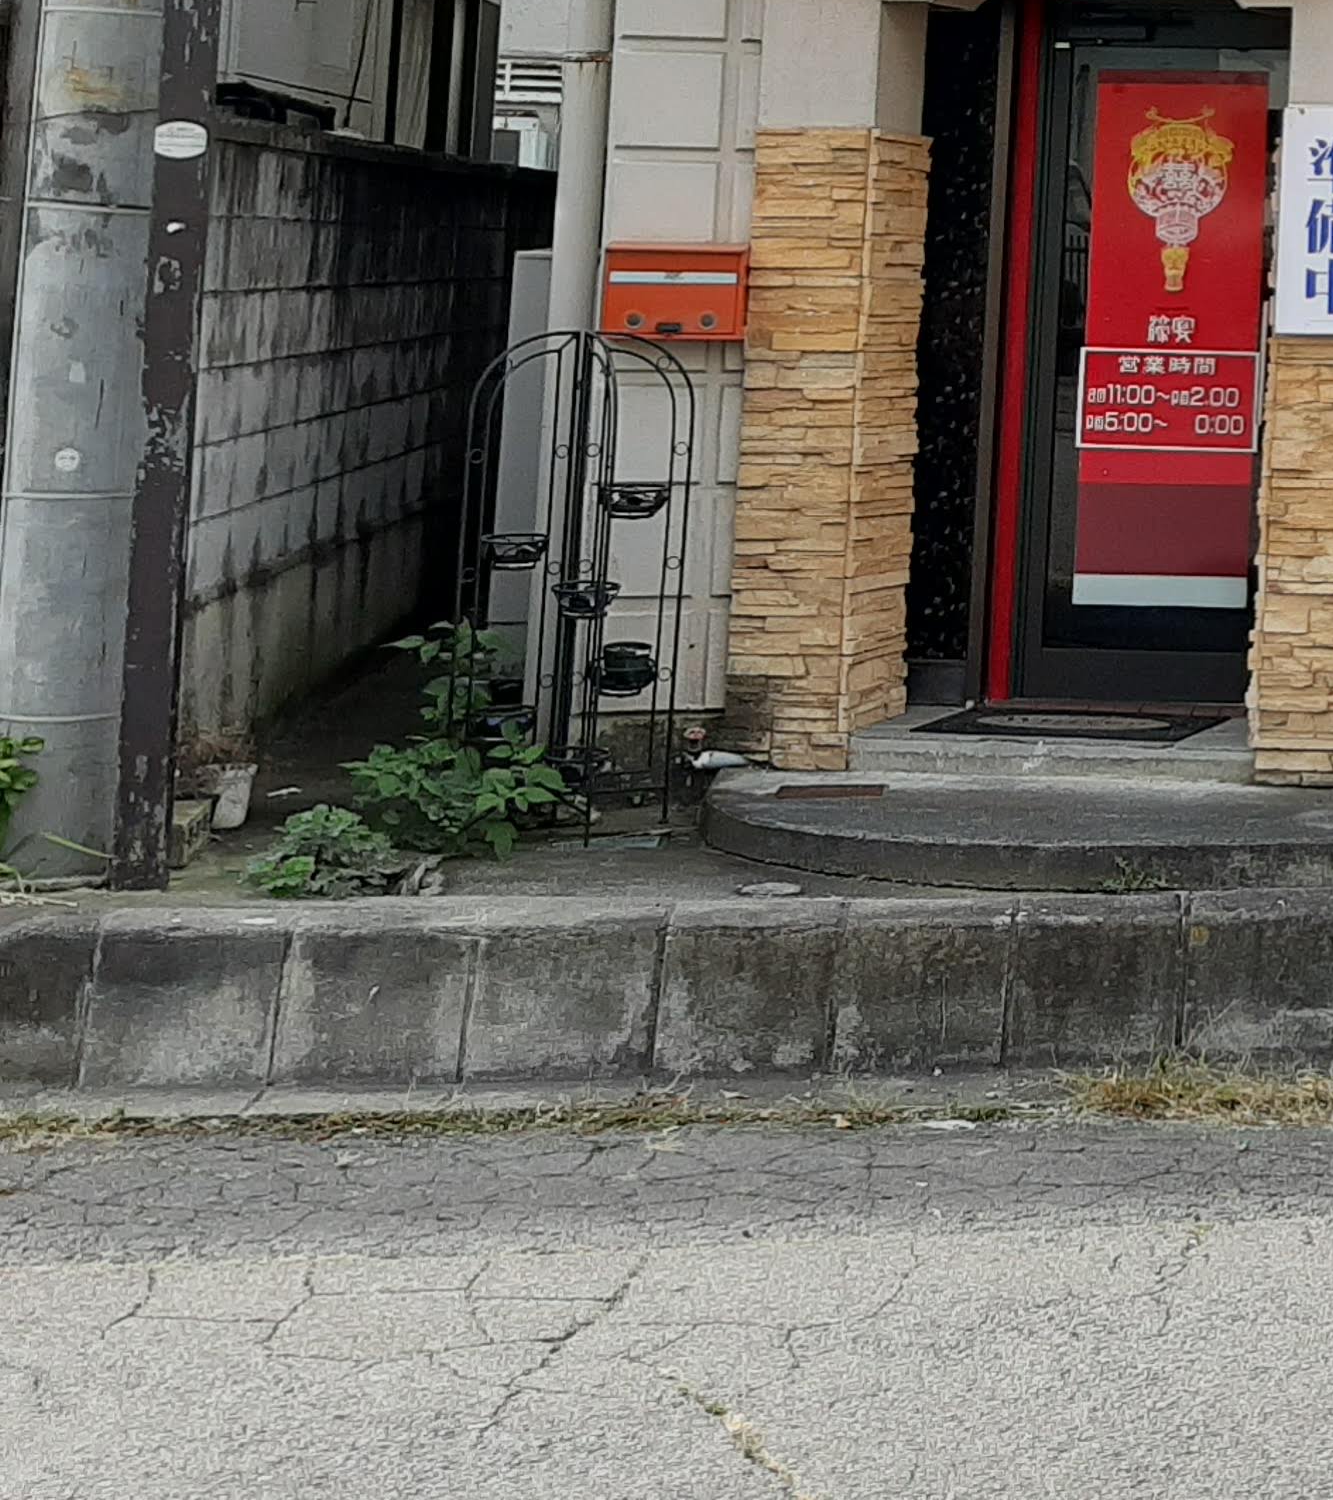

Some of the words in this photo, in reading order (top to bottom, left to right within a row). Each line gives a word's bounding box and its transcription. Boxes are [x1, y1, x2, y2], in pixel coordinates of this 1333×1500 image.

[1118, 355, 1216, 375] 営業時間
[1195, 414, 1244, 435] 0:00
